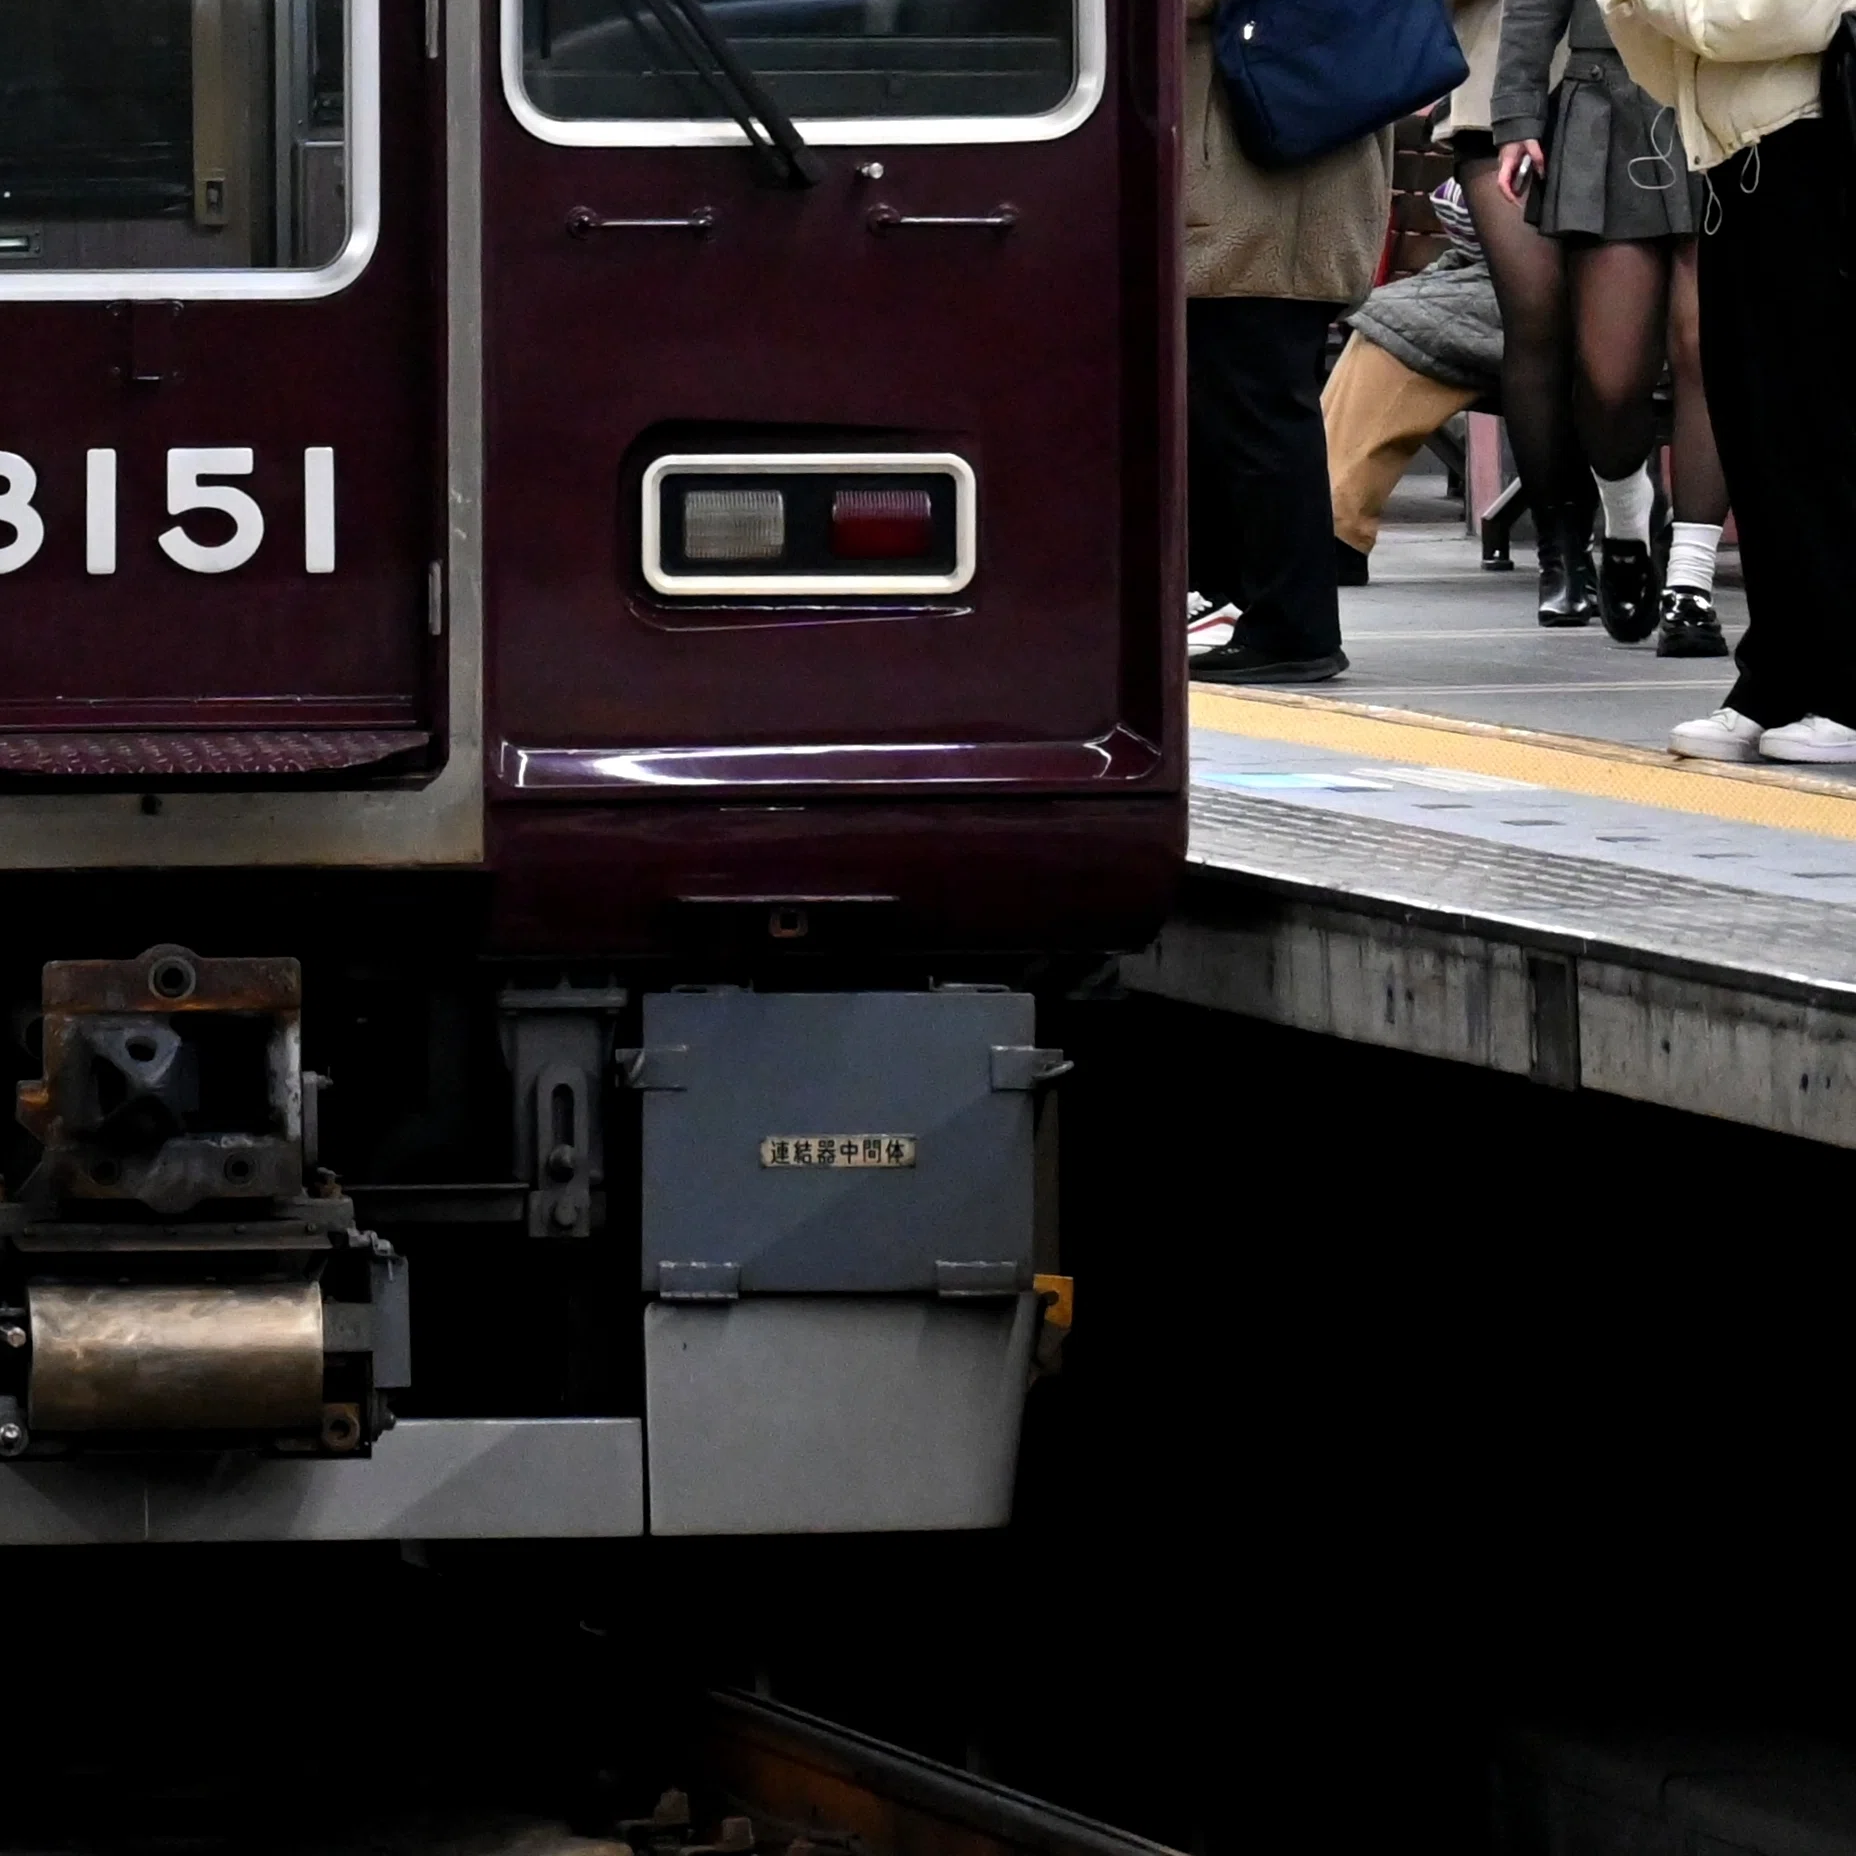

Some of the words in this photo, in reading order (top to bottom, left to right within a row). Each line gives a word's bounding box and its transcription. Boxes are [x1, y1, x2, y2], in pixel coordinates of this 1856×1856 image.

[770, 1140, 906, 1165] 連結器中間体
